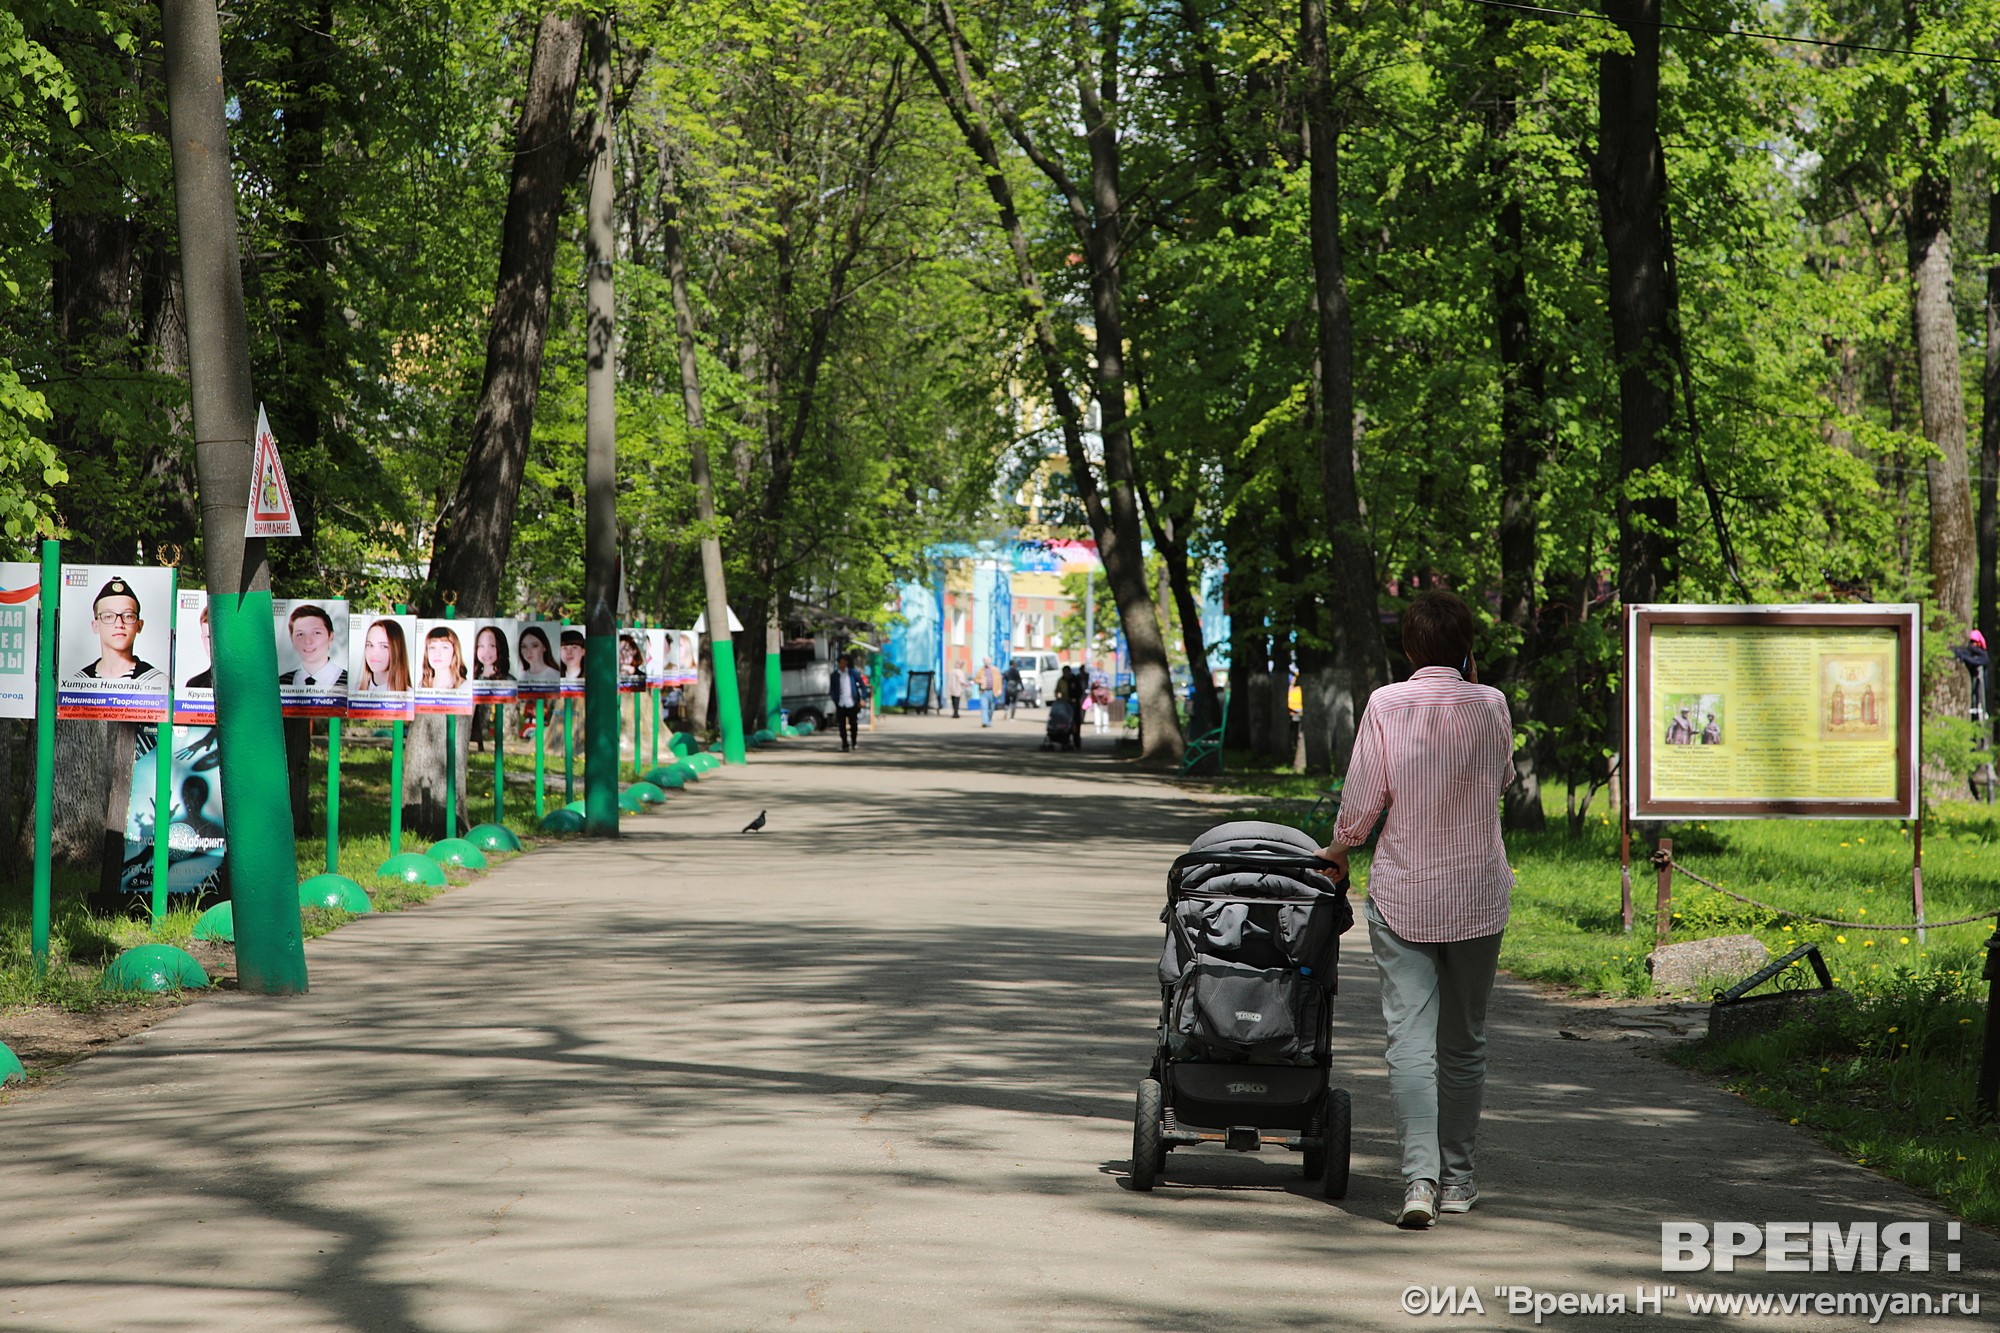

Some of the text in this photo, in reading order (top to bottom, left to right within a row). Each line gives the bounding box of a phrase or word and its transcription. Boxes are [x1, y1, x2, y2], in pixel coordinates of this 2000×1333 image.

[250, 434, 262, 508] МАРШРУТ
[254, 522, 292, 534] ВНИМАНИЕ!
[60, 680, 97, 690] Хитров
[100, 681, 142, 690] Николай,
[62, 696, 164, 706] Номинация "Творчество"
[1235, 1011, 1262, 1022] TAKO
[1227, 1083, 1267, 1093] TAKO
